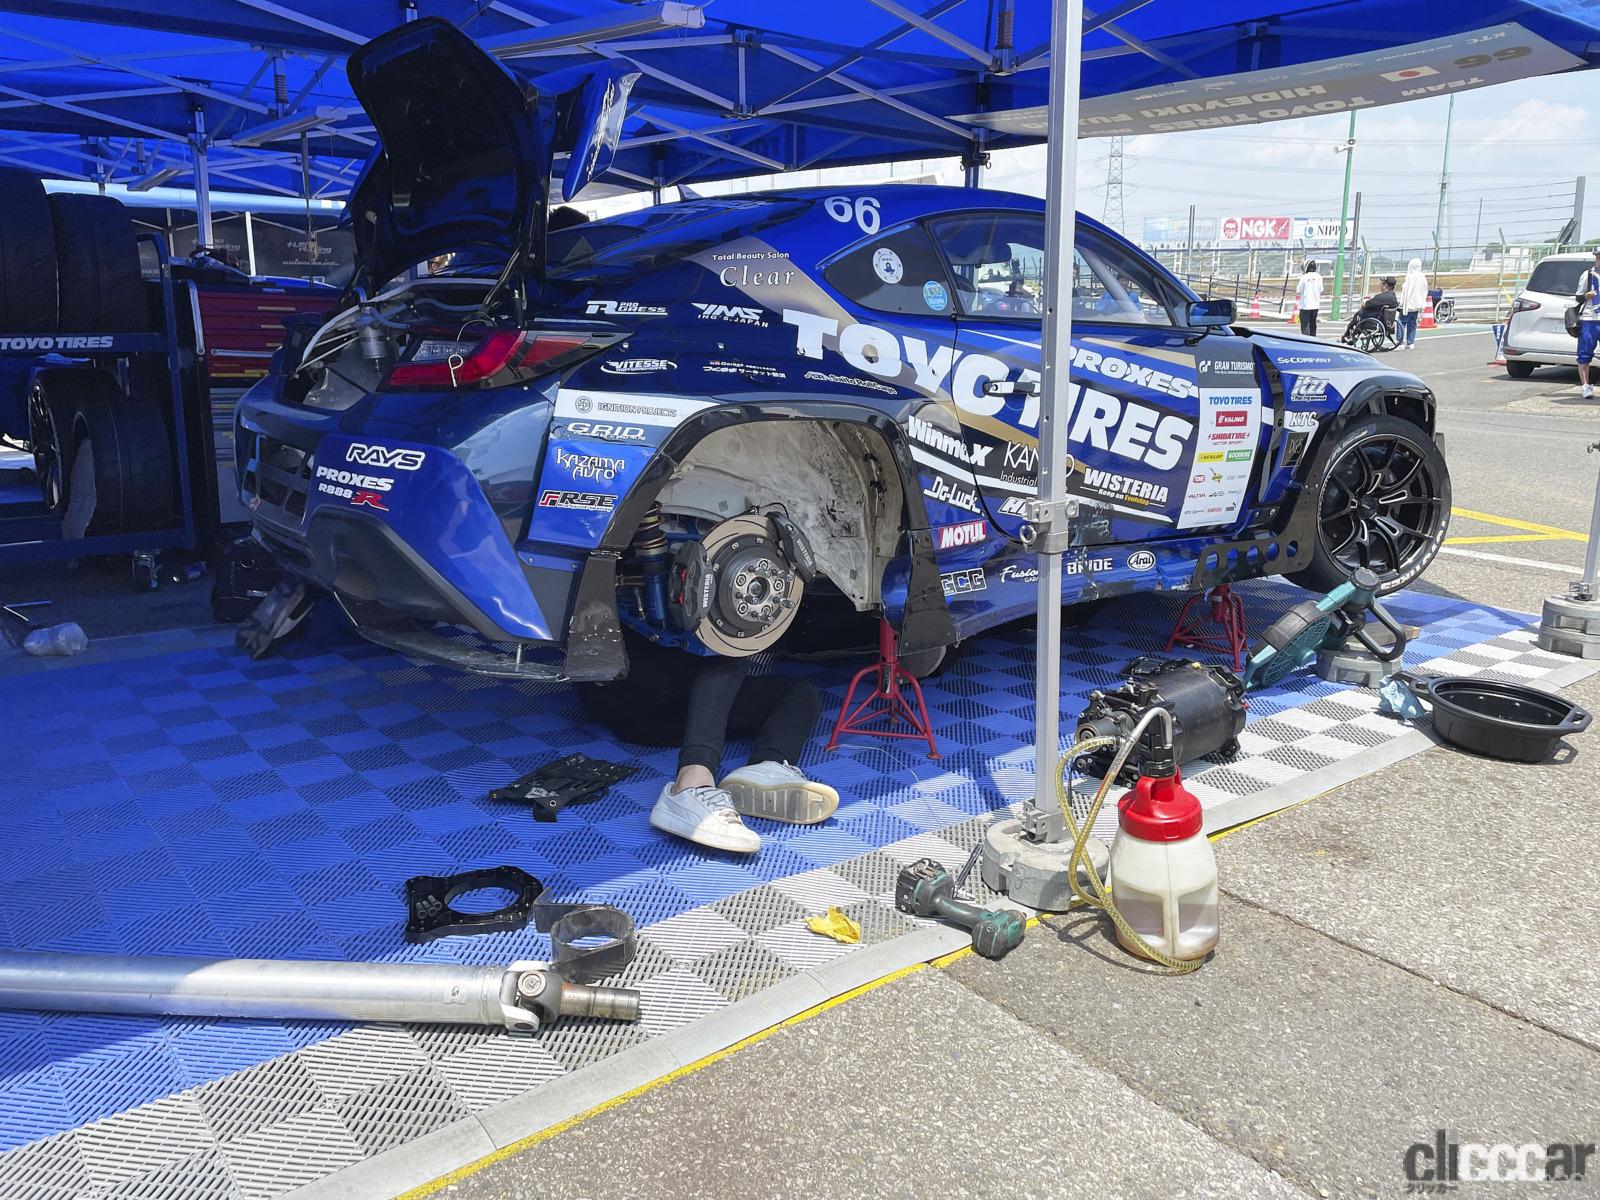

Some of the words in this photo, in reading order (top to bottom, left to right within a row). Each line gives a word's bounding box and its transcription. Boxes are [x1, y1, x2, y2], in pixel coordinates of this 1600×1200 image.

[1401, 77, 1484, 97] TEAM
[1141, 84, 1327, 118] HIDEYUKI
[1258, 96, 1375, 118] TOYO
[1149, 113, 1253, 131] TIRES
[824, 197, 881, 234] 66
[1242, 220, 1276, 238] NGK
[712, 253, 735, 261] Total
[737, 252, 765, 262] Beauty
[767, 251, 790, 260] Salon
[719, 265, 795, 288] Clear
[0, 337, 54, 349] TOYO
[57, 336, 114, 349] TIRES
[610, 360, 668, 369] VITESSE
[783, 309, 1010, 417] TOYO
[1214, 361, 1230, 371] GRAN
[1231, 361, 1254, 371] TURISMO
[598, 402, 636, 414] IGNITION
[637, 404, 677, 417] PROJECTS
[1209, 397, 1230, 405] TOYO
[1231, 396, 1252, 405] TIRES
[1288, 411, 1317, 427] KTC
[567, 422, 646, 438] GRID
[908, 415, 993, 467] Winmax
[346, 443, 425, 471] RAYS
[557, 448, 625, 473] KAZAMA
[316, 466, 394, 492] PROXES
[1001, 471, 1038, 487] Industrial
[1083, 467, 1169, 504] WISTERIA
[1098, 489, 1115, 499] Keep
[1125, 495, 1149, 507] Evolving
[940, 522, 987, 548] MOTUL
[1132, 554, 1152, 567] Arai
[1000, 565, 1039, 583] Fusio
